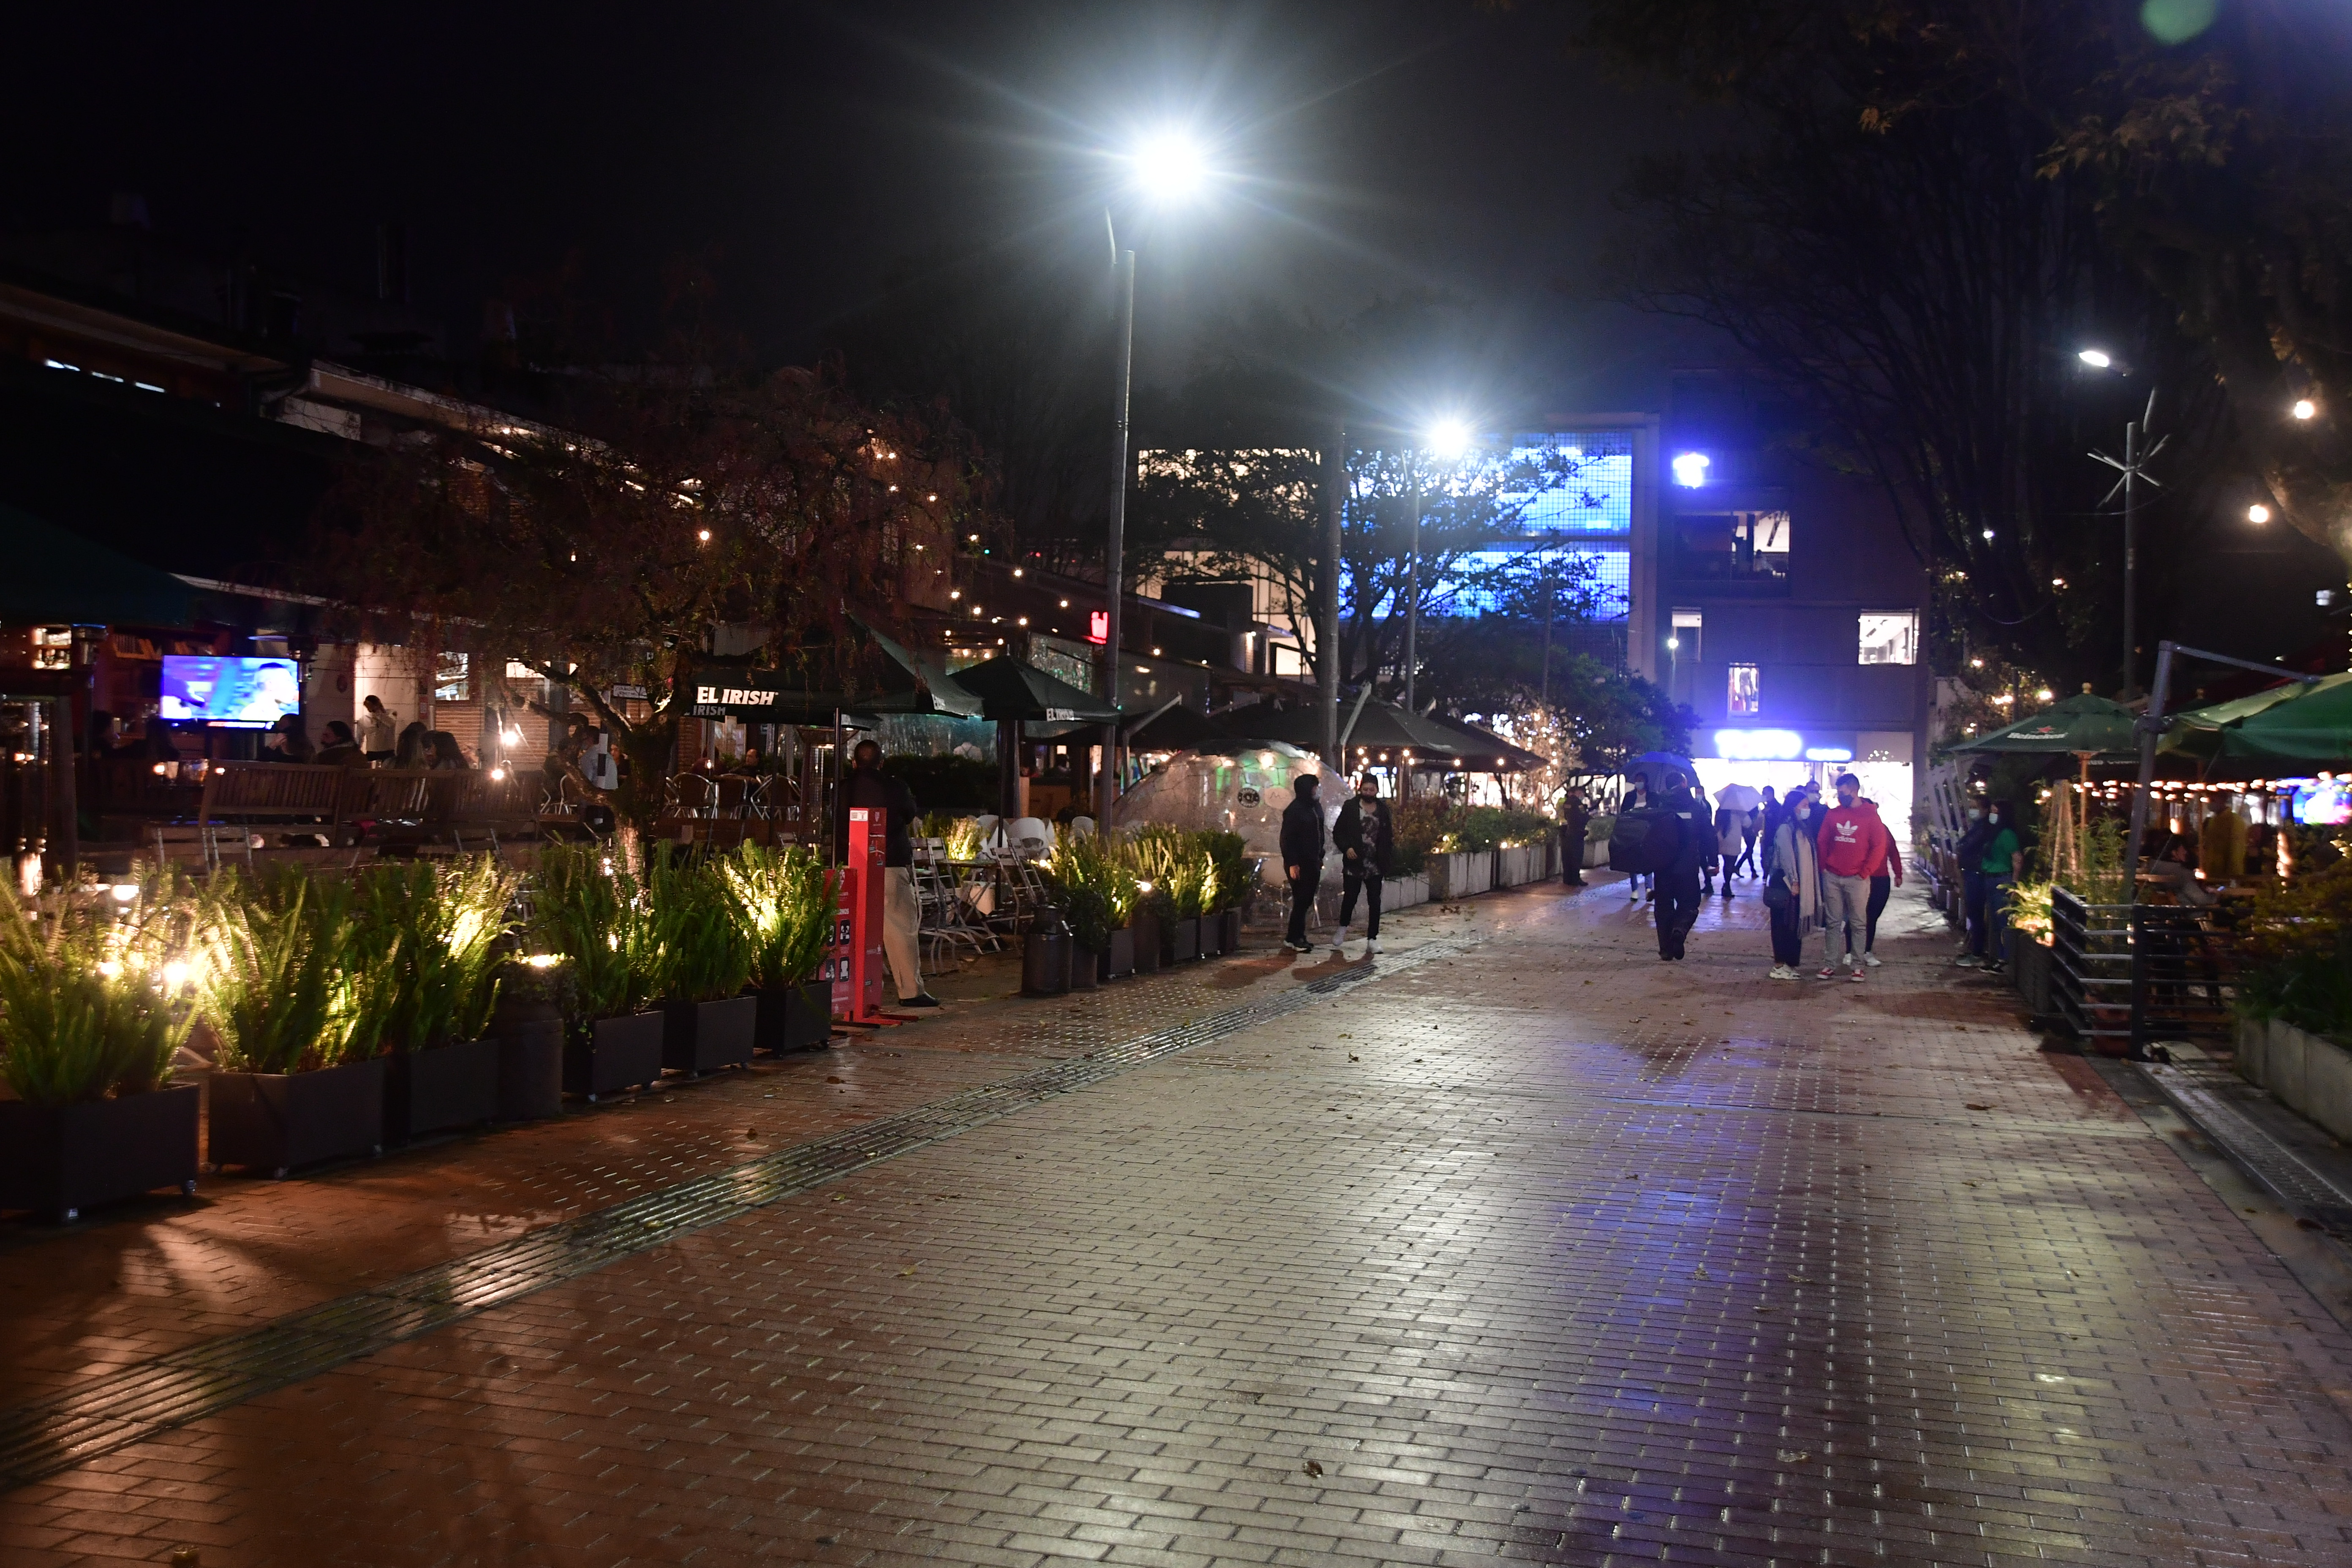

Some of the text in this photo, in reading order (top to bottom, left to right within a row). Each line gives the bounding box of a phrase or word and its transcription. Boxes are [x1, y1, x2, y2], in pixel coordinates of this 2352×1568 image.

[697, 686, 776, 705] EL IRISH
[692, 705, 726, 716] IRISH
